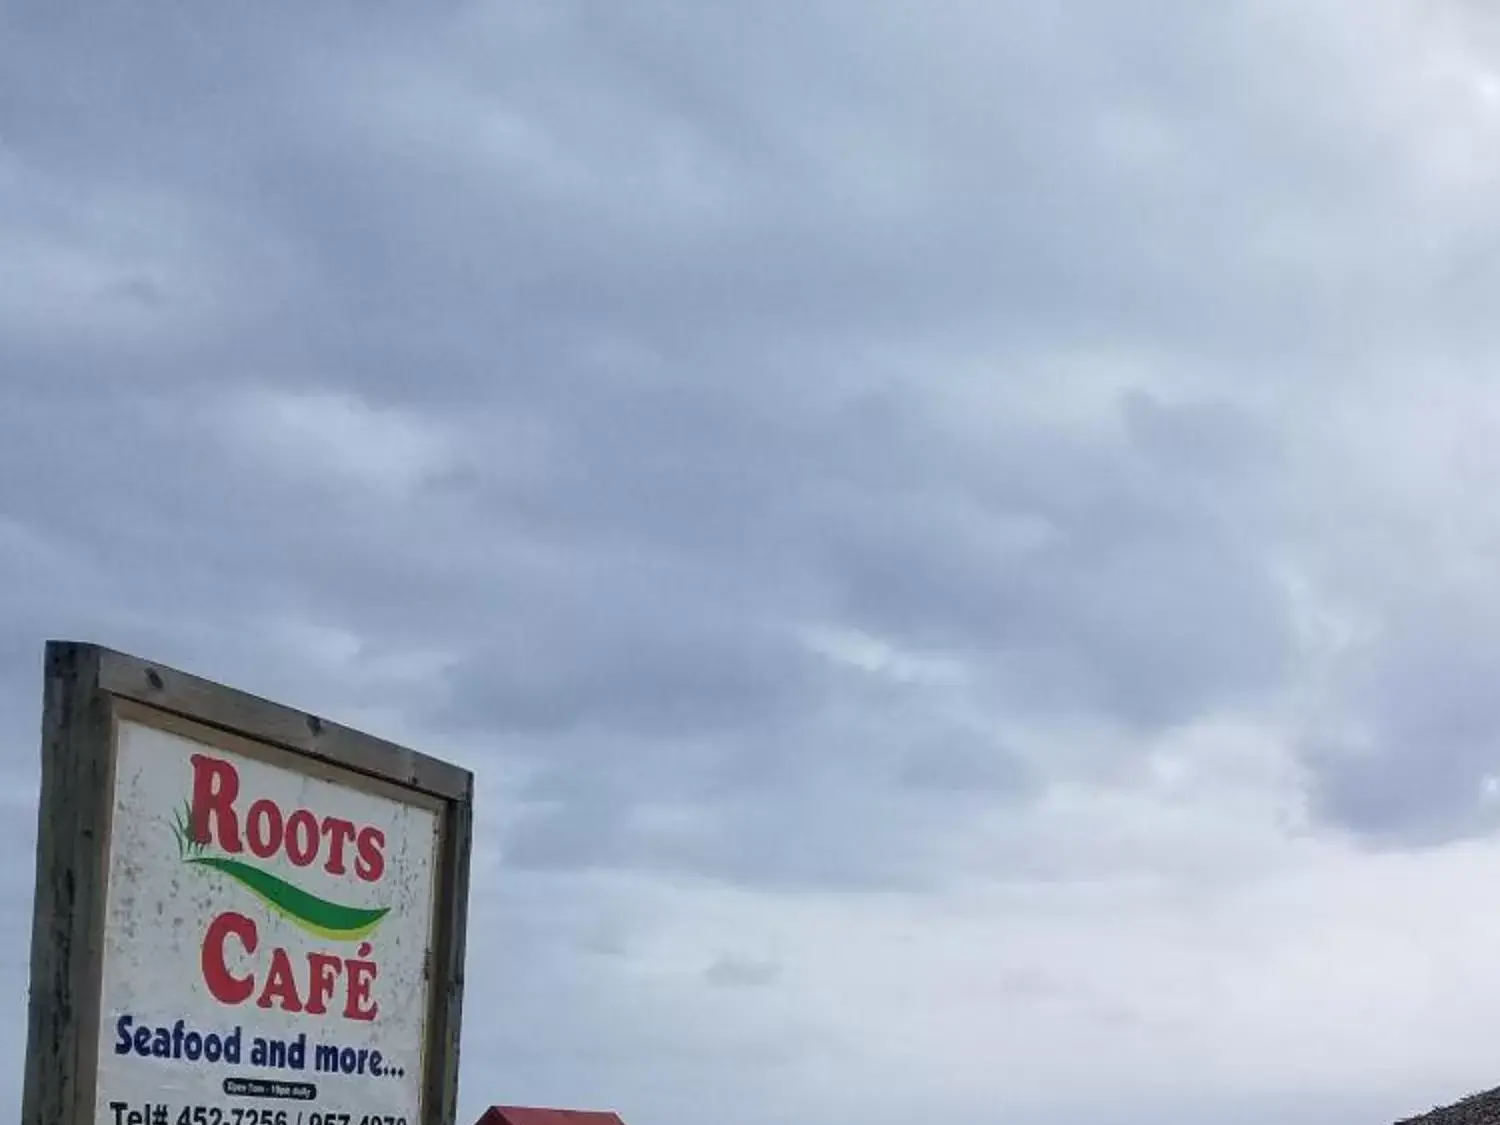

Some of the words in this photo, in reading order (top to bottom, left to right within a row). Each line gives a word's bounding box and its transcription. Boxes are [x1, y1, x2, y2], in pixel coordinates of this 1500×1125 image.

[190, 753, 385, 882] ROOTS
[115, 1015, 242, 1064] Seafood
[251, 1033, 306, 1070] and
[315, 1043, 405, 1077] more...
